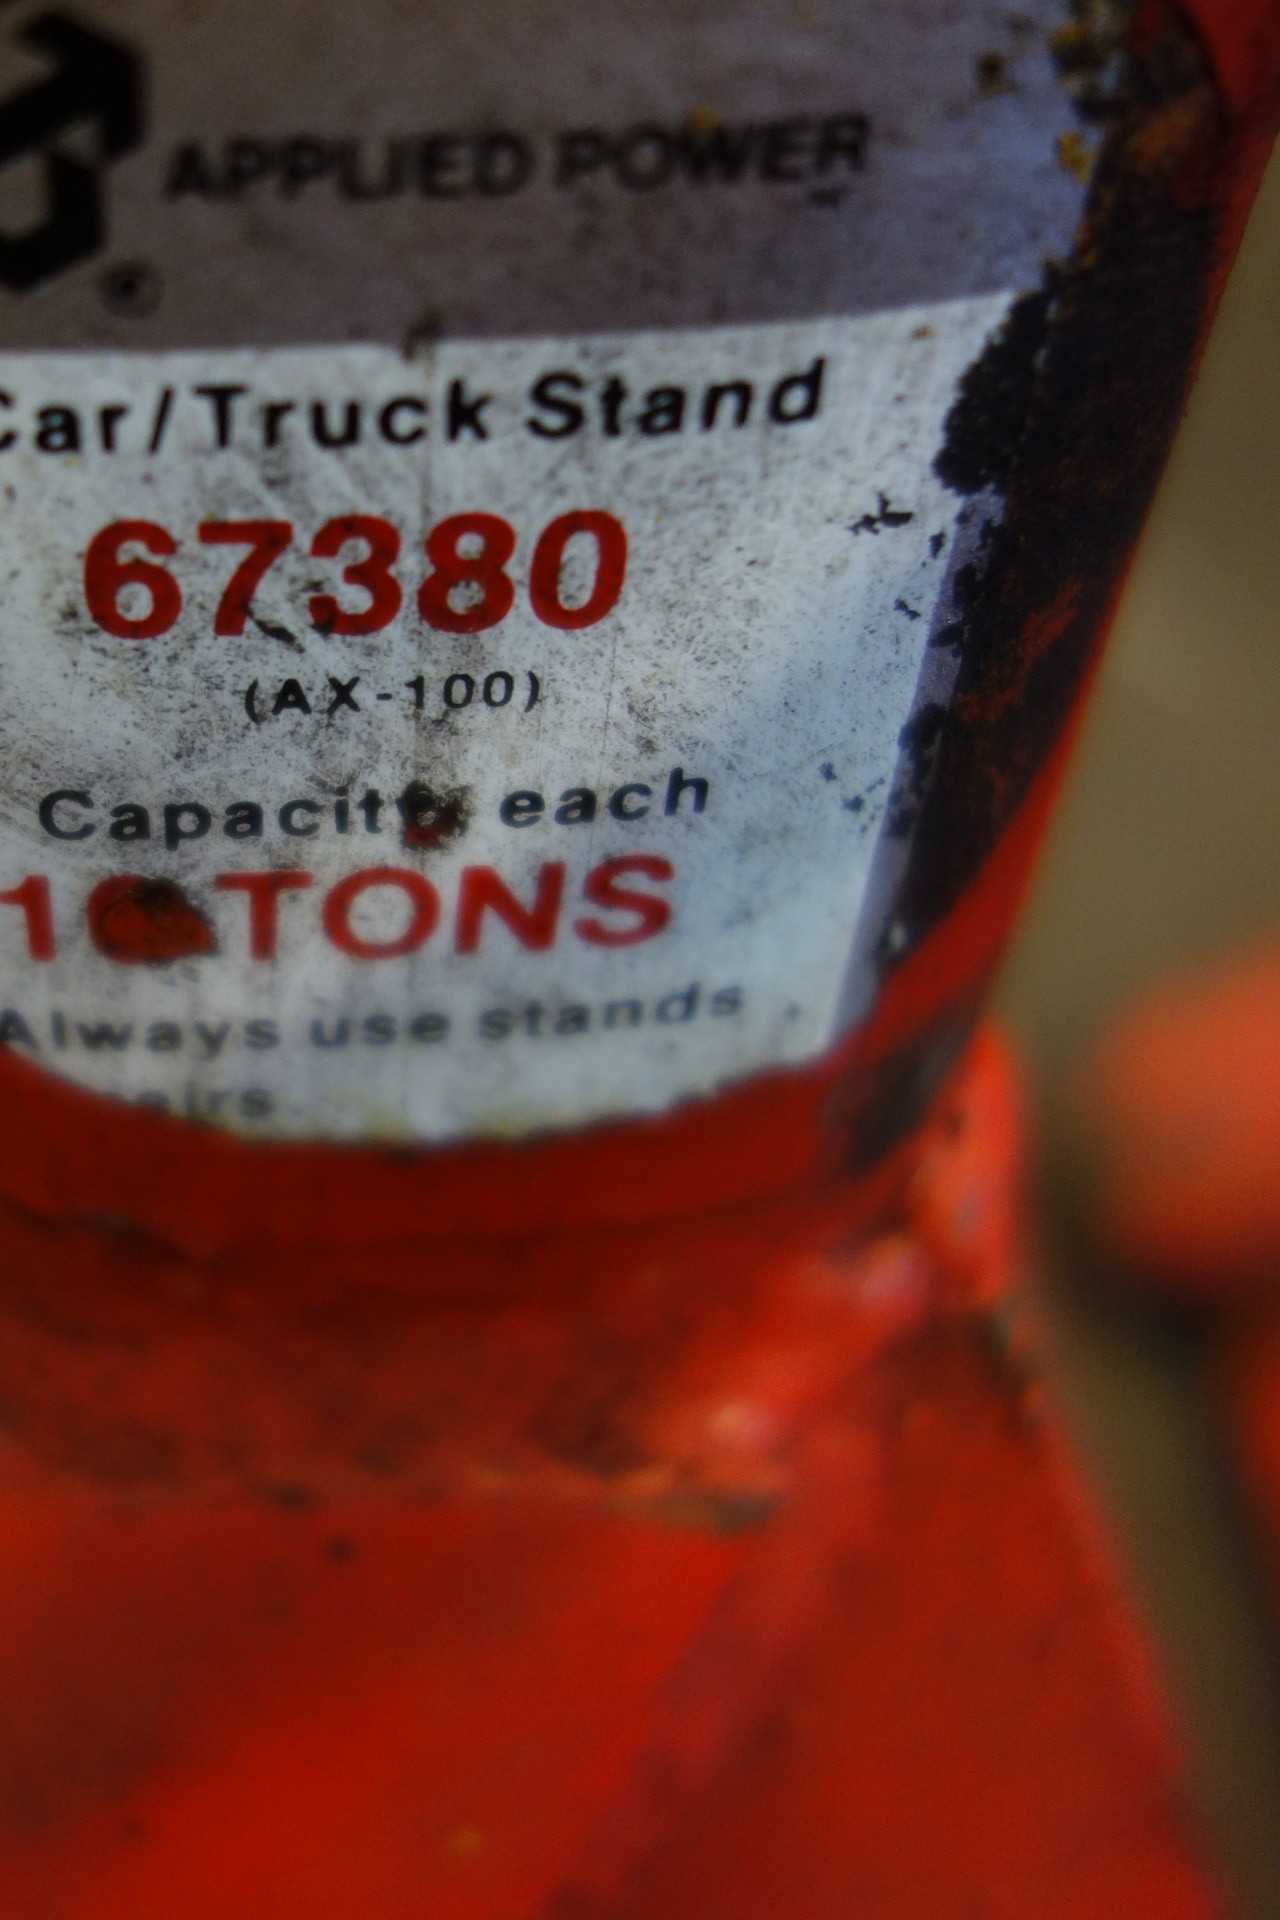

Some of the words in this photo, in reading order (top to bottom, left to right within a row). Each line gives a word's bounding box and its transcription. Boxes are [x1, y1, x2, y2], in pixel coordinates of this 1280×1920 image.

[163, 130, 532, 201] APPLIED
[554, 112, 871, 192] POWER
[526, 358, 827, 439] Stand
[84, 509, 629, 640] 67380
[244, 670, 541, 723] (AX-100)
[499, 767, 711, 829] each
[213, 853, 676, 962] TONS
[0, 1008, 281, 1062] Always
[309, 1006, 450, 1049] use
[477, 981, 745, 1041] stands
